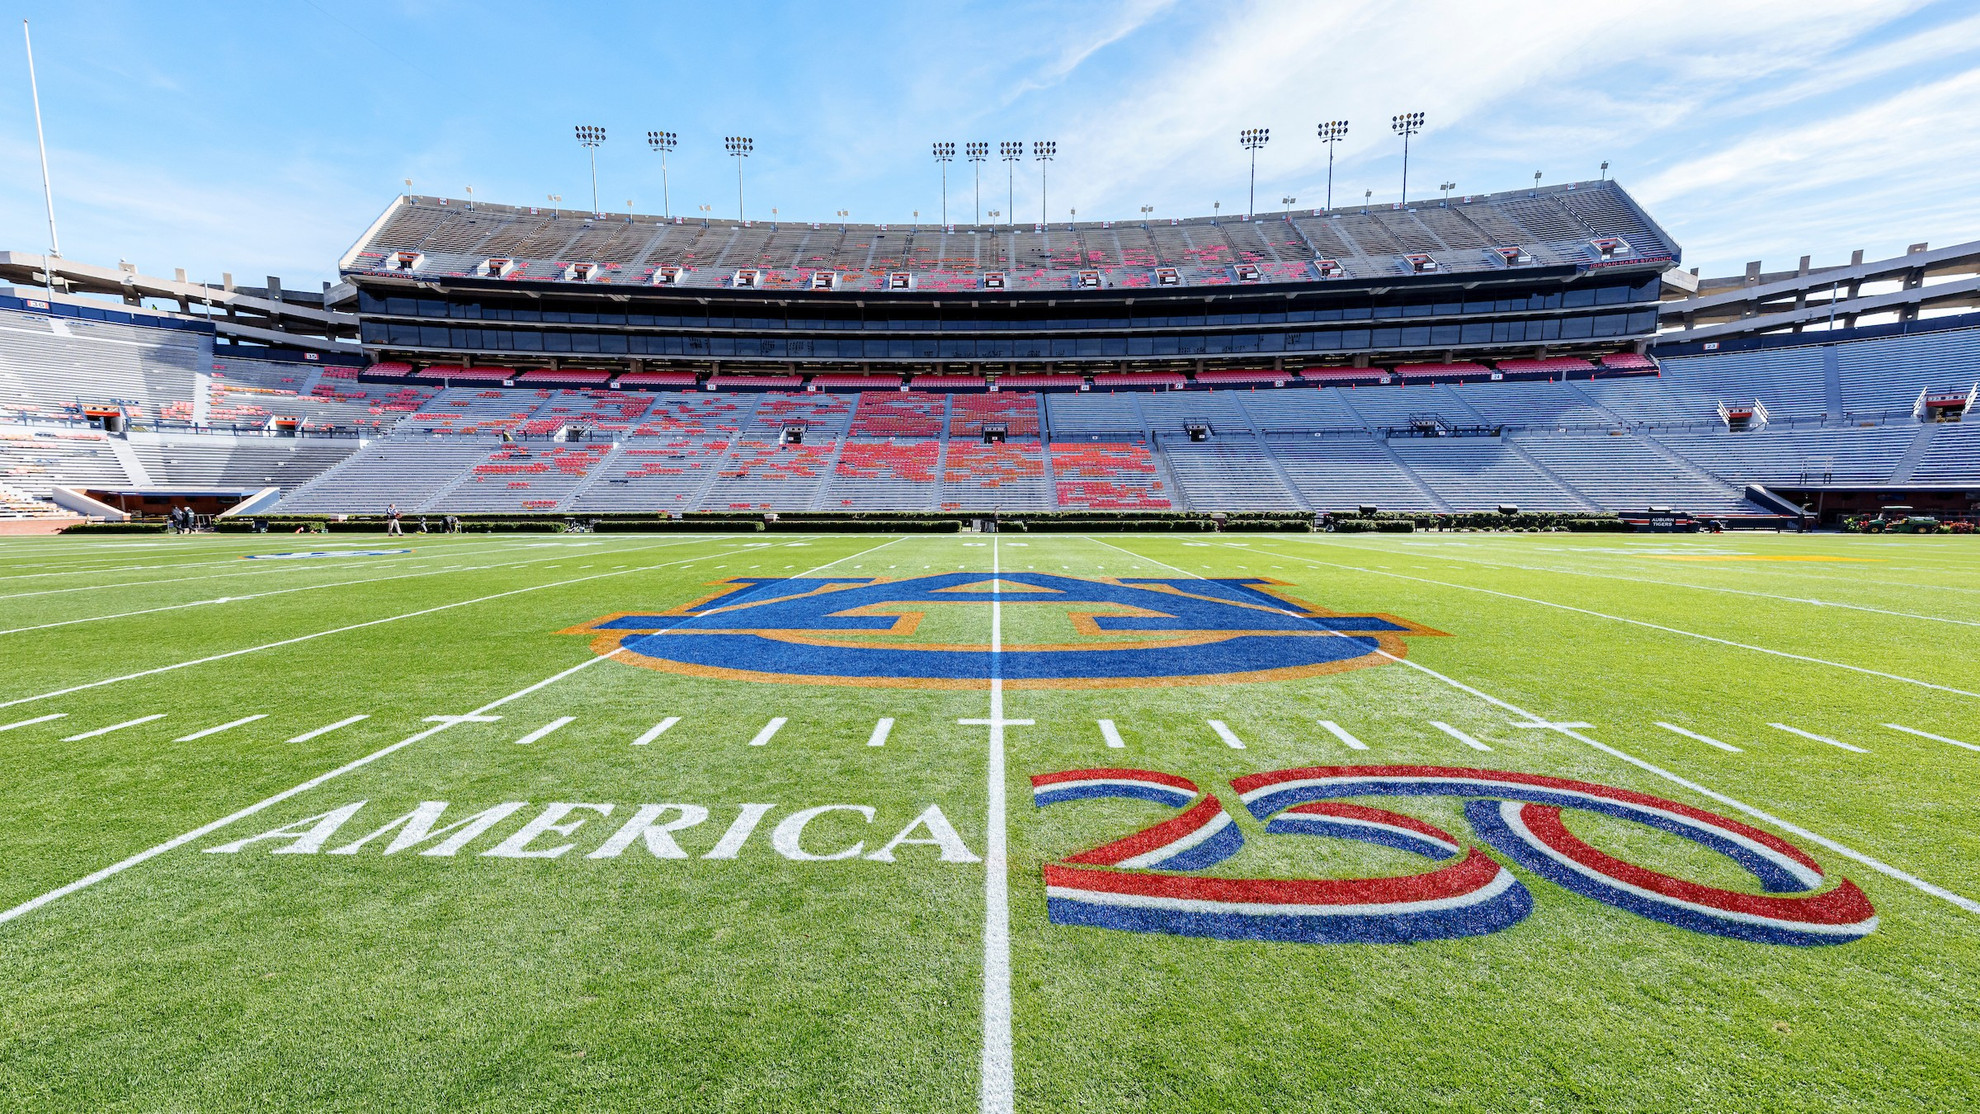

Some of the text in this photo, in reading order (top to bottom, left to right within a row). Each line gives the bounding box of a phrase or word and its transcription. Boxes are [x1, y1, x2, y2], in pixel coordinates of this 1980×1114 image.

[1590, 260, 1638, 268] JORDAN-HARE
[202, 765, 1880, 948] AMERICA 250
